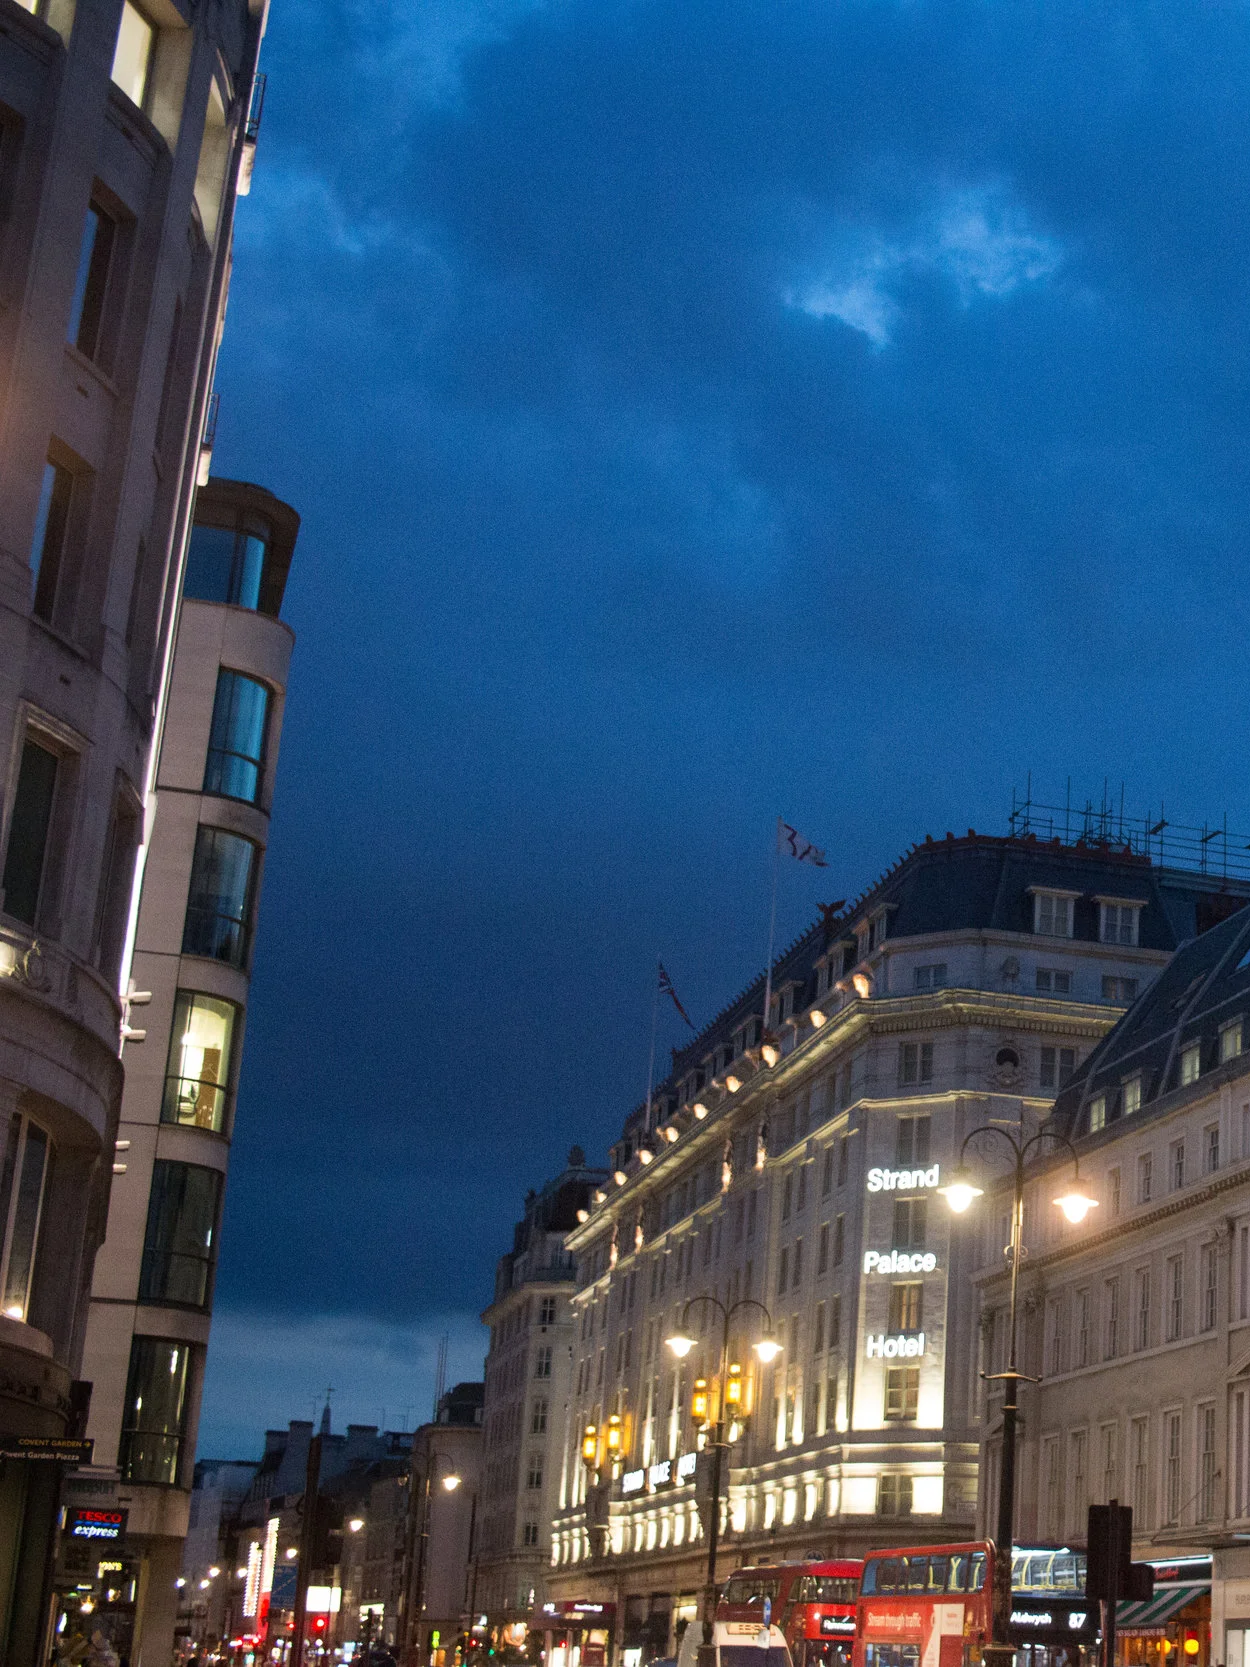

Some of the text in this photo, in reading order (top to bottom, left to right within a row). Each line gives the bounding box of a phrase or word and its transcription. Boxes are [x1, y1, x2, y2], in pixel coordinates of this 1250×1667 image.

[867, 1164, 940, 1192] Strand
[863, 1250, 937, 1274] Palace
[866, 1333, 925, 1359] Hotel
[19, 1439, 82, 1448] COVENT GARDEN
[28, 1451, 55, 1460] Garden
[55, 1452, 80, 1461] Piazza
[76, 1510, 122, 1523] TESCO
[73, 1525, 119, 1538] express
[886, 1612, 905, 1632] through
[1010, 1611, 1087, 1629] Aldwych 87
